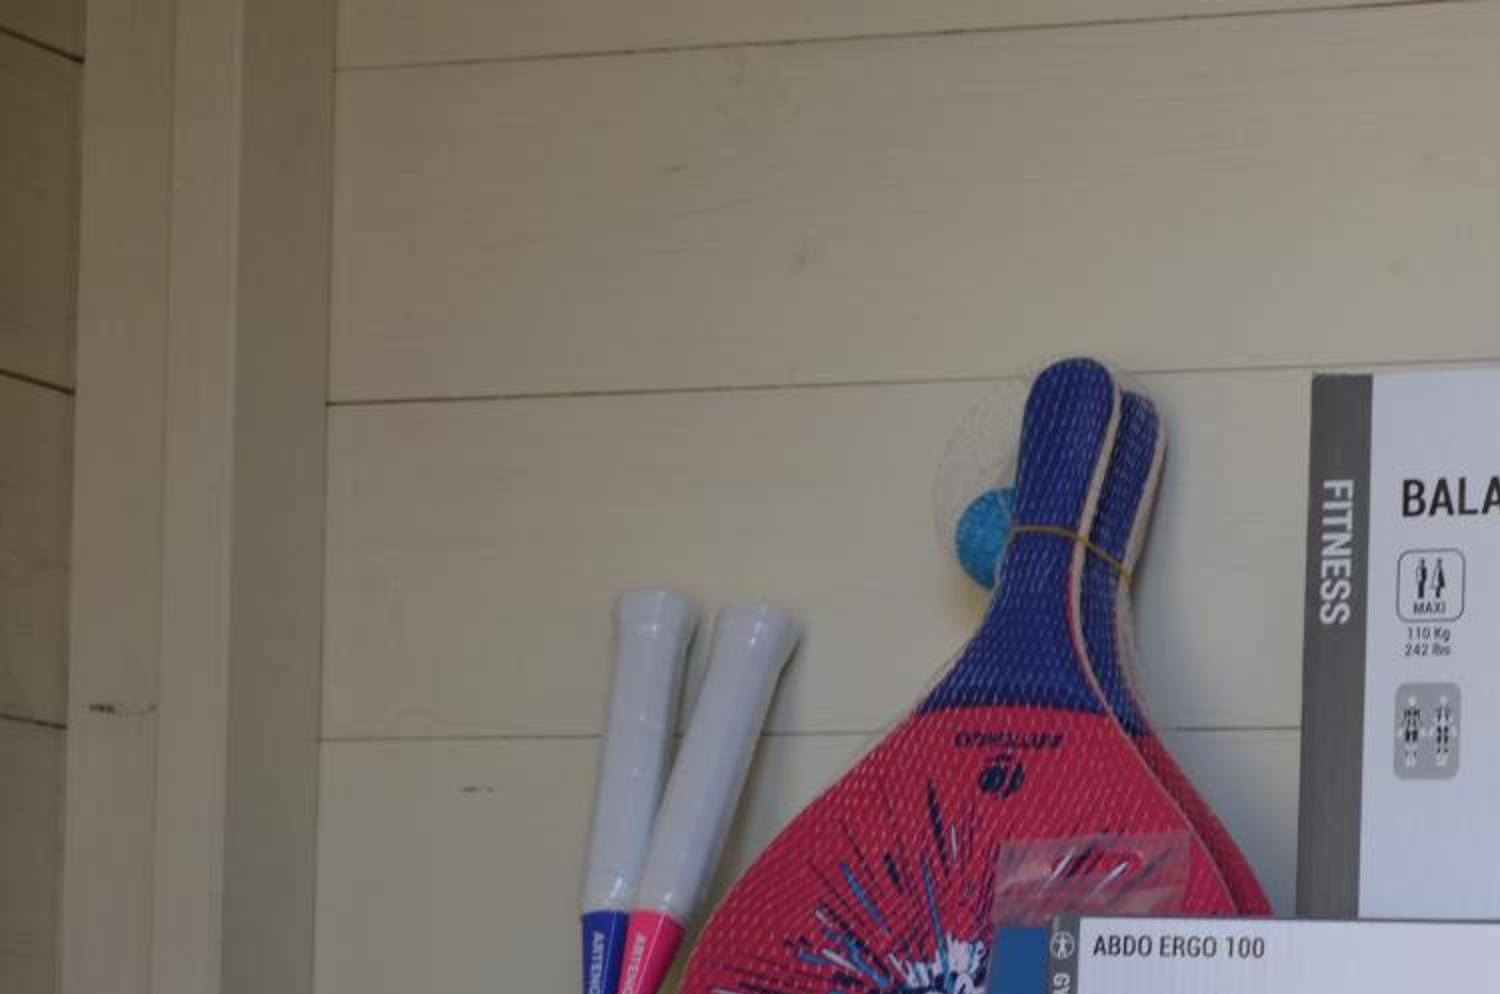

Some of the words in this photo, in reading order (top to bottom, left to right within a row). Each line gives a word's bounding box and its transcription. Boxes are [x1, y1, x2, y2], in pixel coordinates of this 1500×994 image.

[1319, 479, 1355, 626] FITNESS
[1413, 602, 1446, 614] MAXI
[1408, 626, 1431, 640] 110
[1434, 627, 1451, 643] Kg
[1404, 643, 1429, 656] 242
[1092, 934, 1153, 957] ABDO
[1158, 935, 1218, 958] ERGO
[1225, 936, 1266, 960] 100
